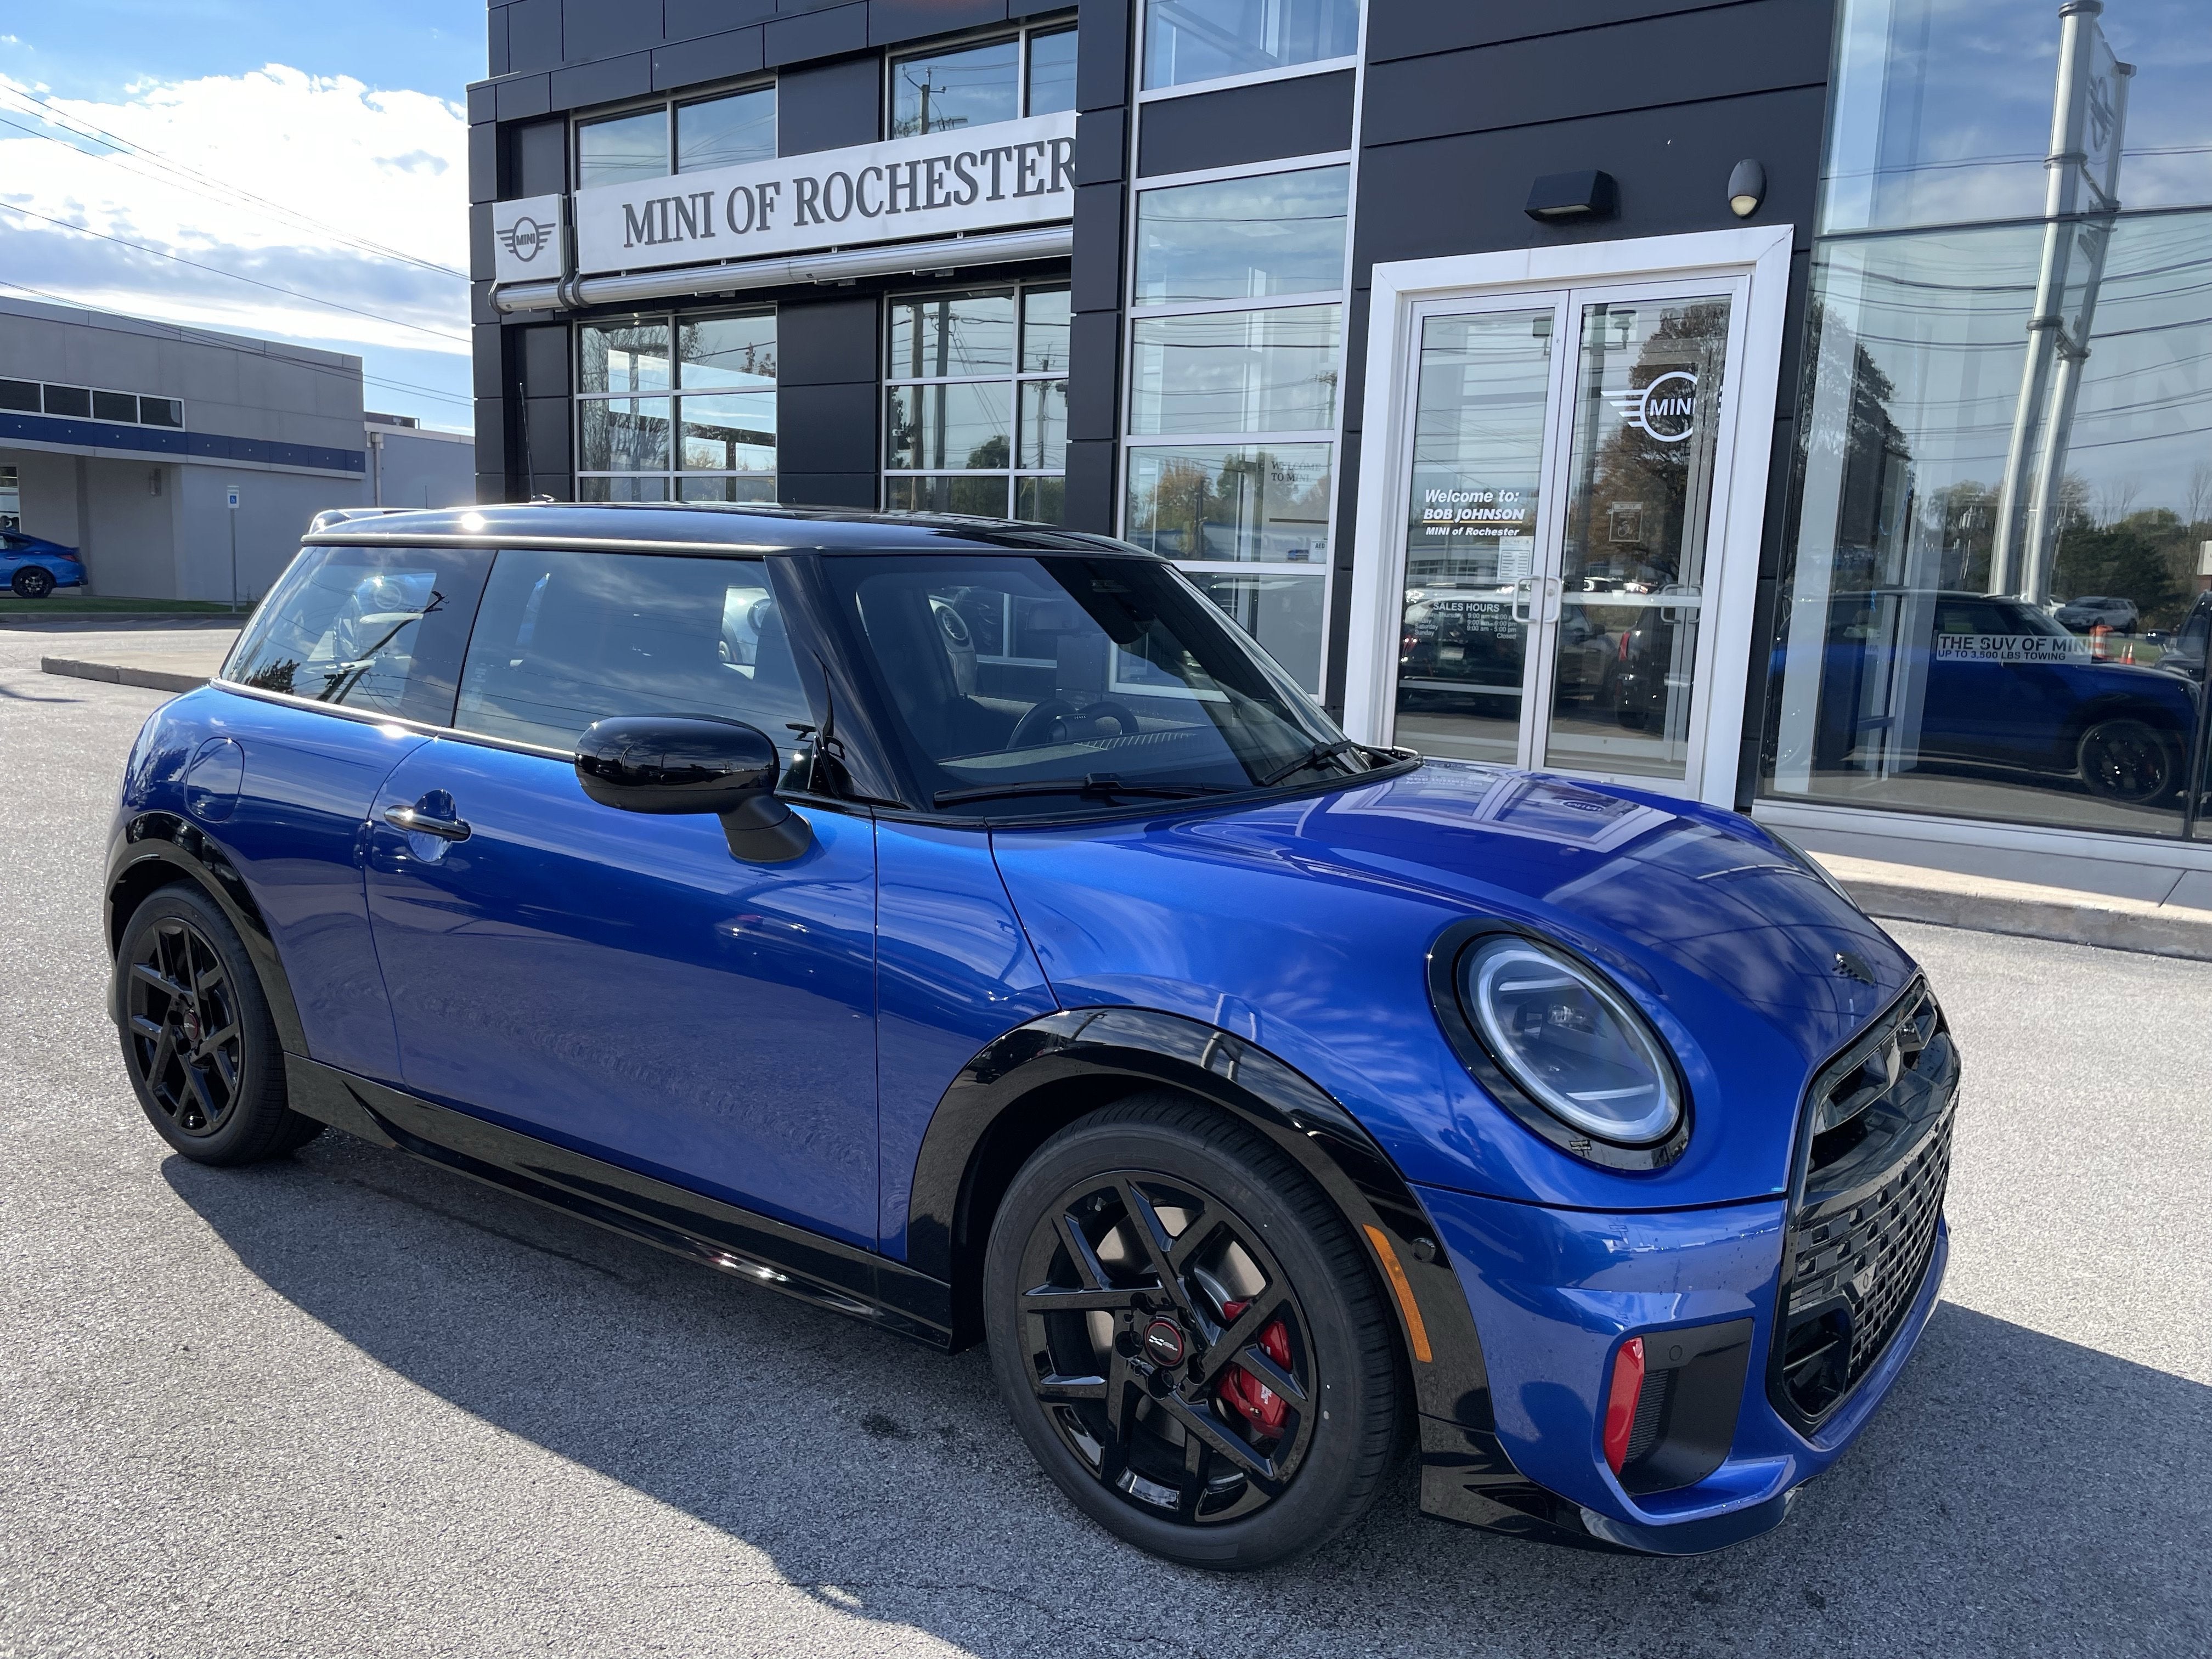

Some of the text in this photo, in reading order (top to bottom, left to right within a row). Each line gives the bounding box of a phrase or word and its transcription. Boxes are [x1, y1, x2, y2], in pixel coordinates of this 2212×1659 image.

[622, 137, 1075, 248] MINI OF ROCHESTER
[516, 233, 535, 245] MINI
[1271, 472, 1284, 482] TO
[1425, 489, 1519, 503] Welcome to:
[1423, 509, 1525, 522] BOB JOHNSON
[1426, 527, 1520, 536] MINI of Rochester
[1432, 603, 1500, 612] SALES HOURS
[1939, 636, 1974, 650] THE
[1979, 637, 2017, 650] SUV
[2021, 637, 2048, 651] OF
